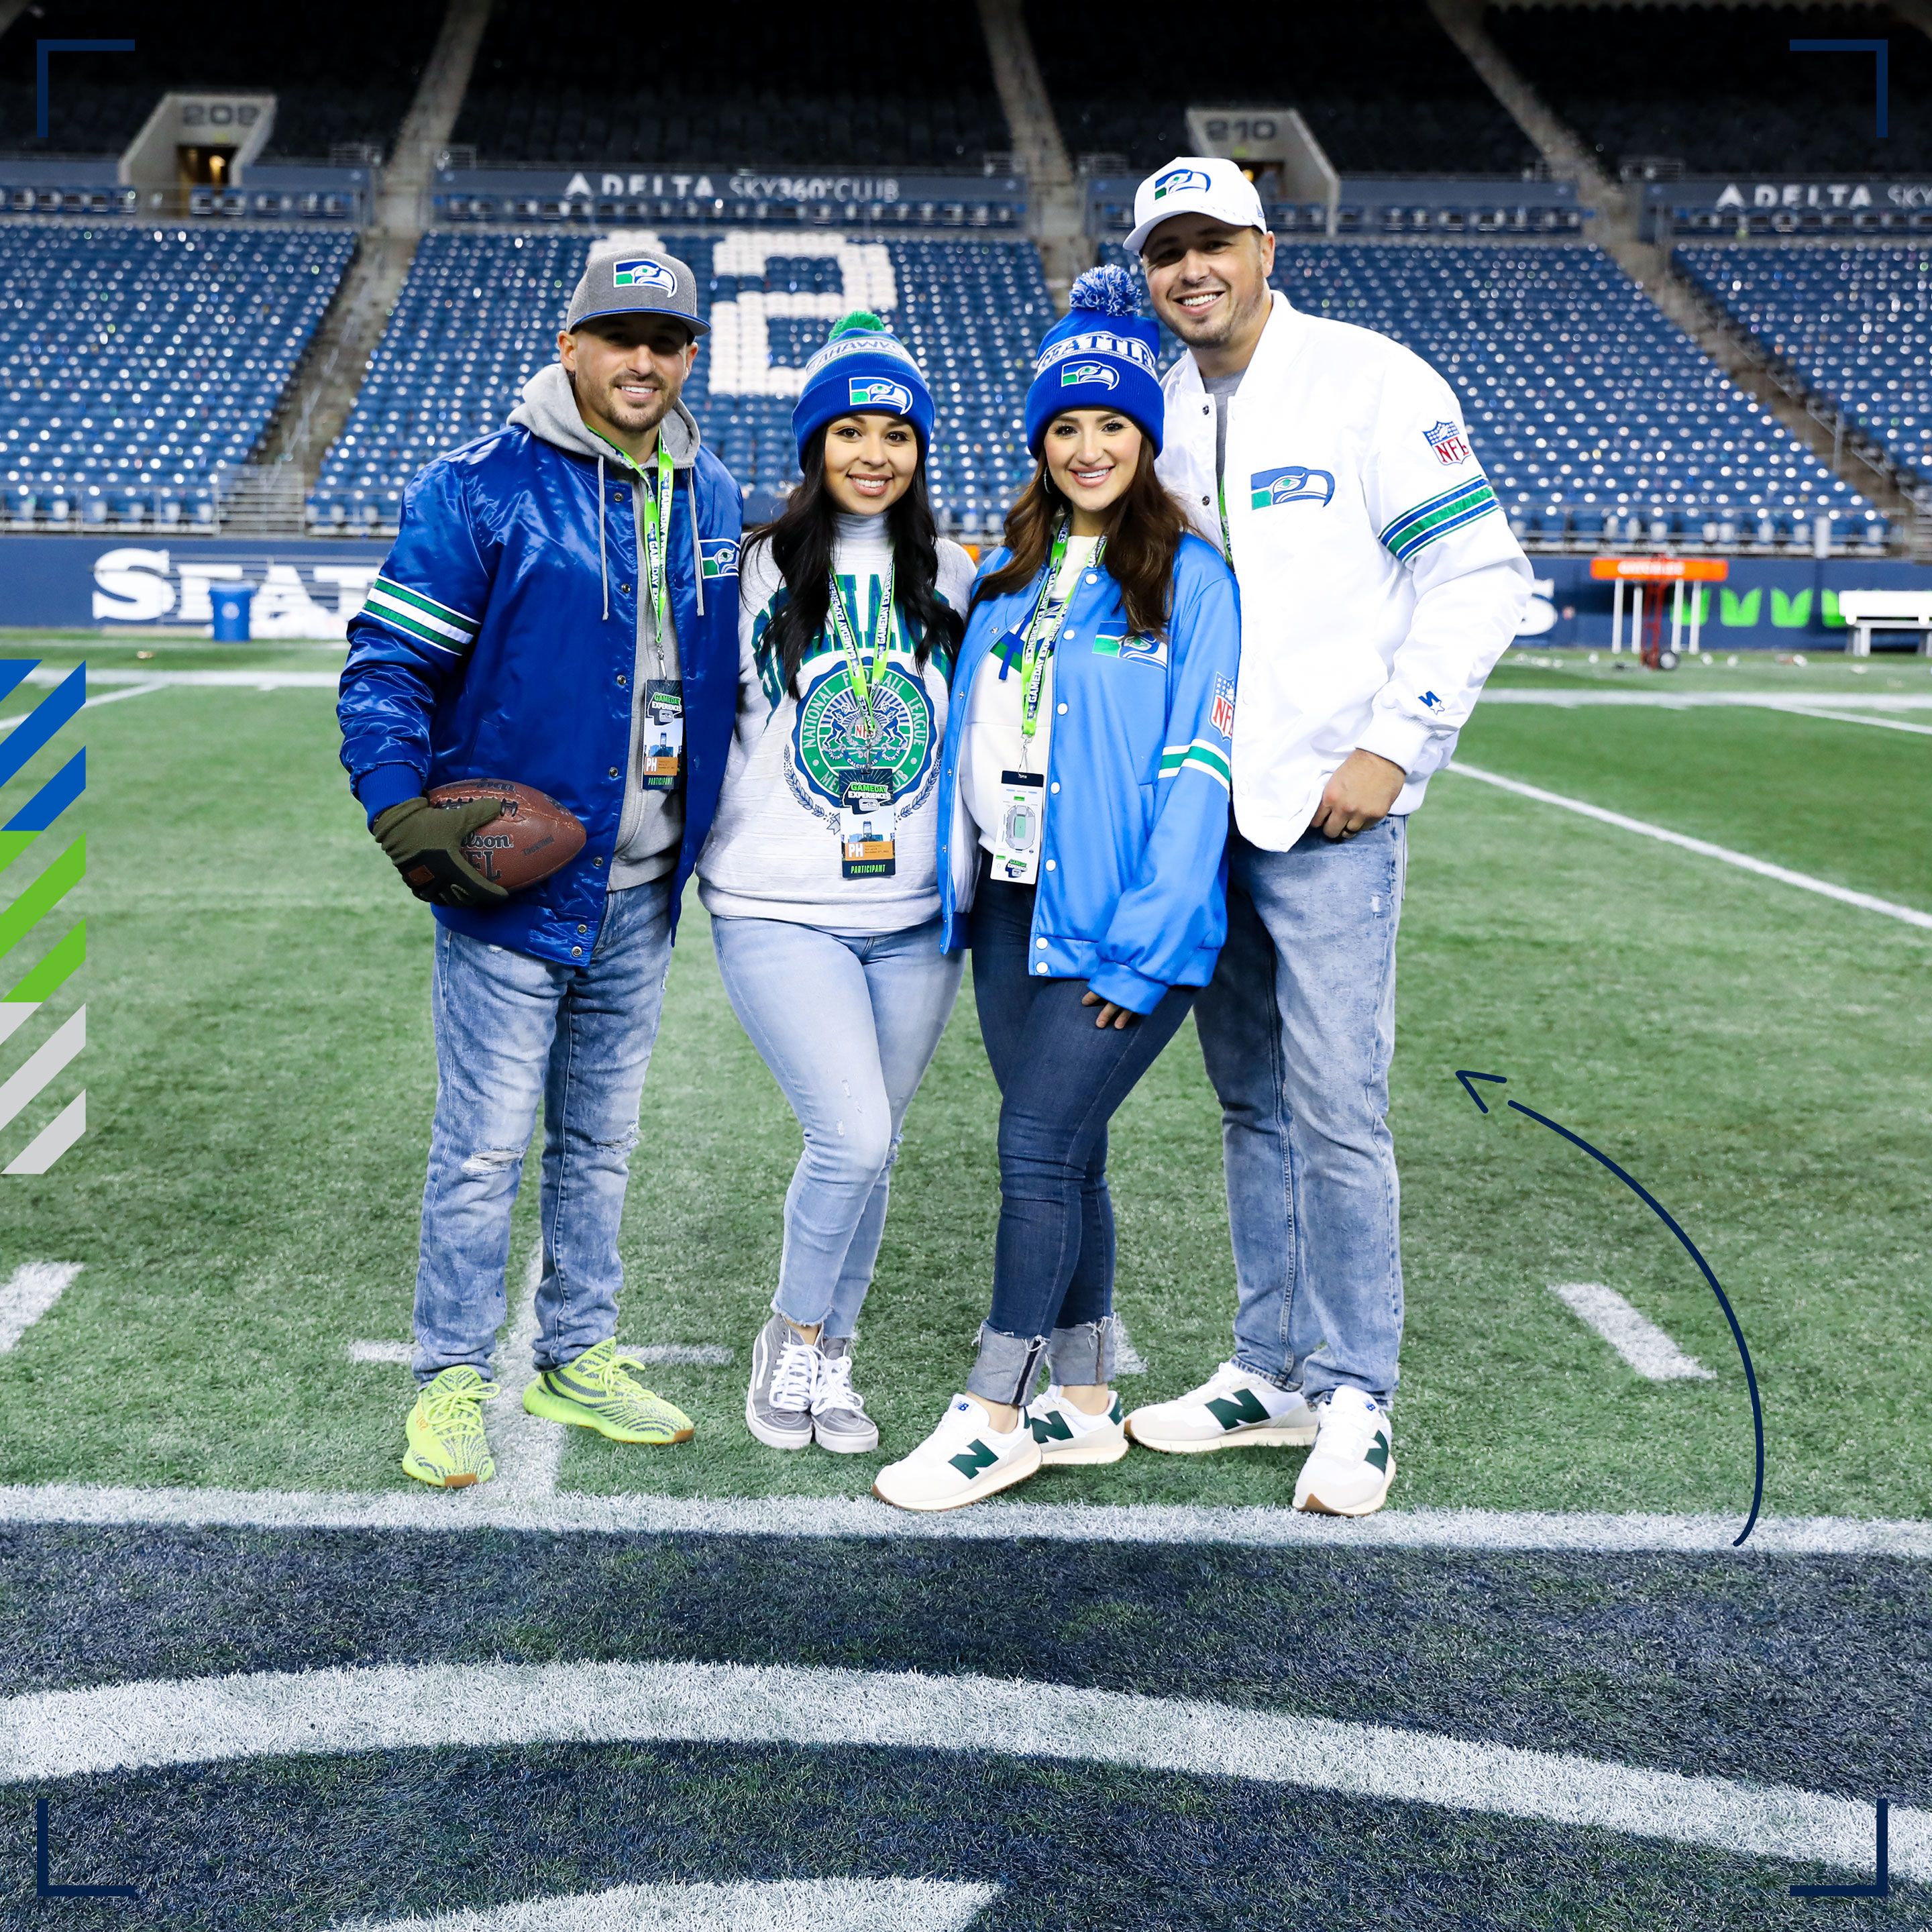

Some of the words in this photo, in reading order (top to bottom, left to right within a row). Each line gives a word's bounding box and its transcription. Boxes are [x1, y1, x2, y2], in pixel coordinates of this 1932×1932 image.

[1205, 118, 1277, 142] 210
[602, 174, 714, 197] DELTA
[1754, 183, 1872, 210] DELTA
[1434, 437, 1469, 463] NFL
[660, 488, 670, 534] GAMEDAY
[649, 541, 659, 586] GAMEDAY
[1039, 573, 1056, 609] GAMEDAY
[838, 621, 857, 659] GAMEDAY
[877, 606, 890, 645] GAMEDAY
[1025, 610, 1044, 664] EXPERIENCES
[1028, 659, 1044, 703] GAMEDAY
[651, 701, 682, 711] EXPERIENCES
[654, 693, 680, 704] GAMEDAY
[803, 686, 835, 748] NATIONAL
[906, 697, 926, 747] LEAGUE
[646, 757, 657, 771] PH
[848, 791, 890, 800] EXPERIENCES
[851, 783, 886, 793] GAMEDAY
[848, 843, 863, 857] PH
[465, 850, 502, 881] FL
[851, 864, 885, 873] PARTICIPANT
[1204, 1389, 1271, 1430] N
[948, 1439, 999, 1480] N
